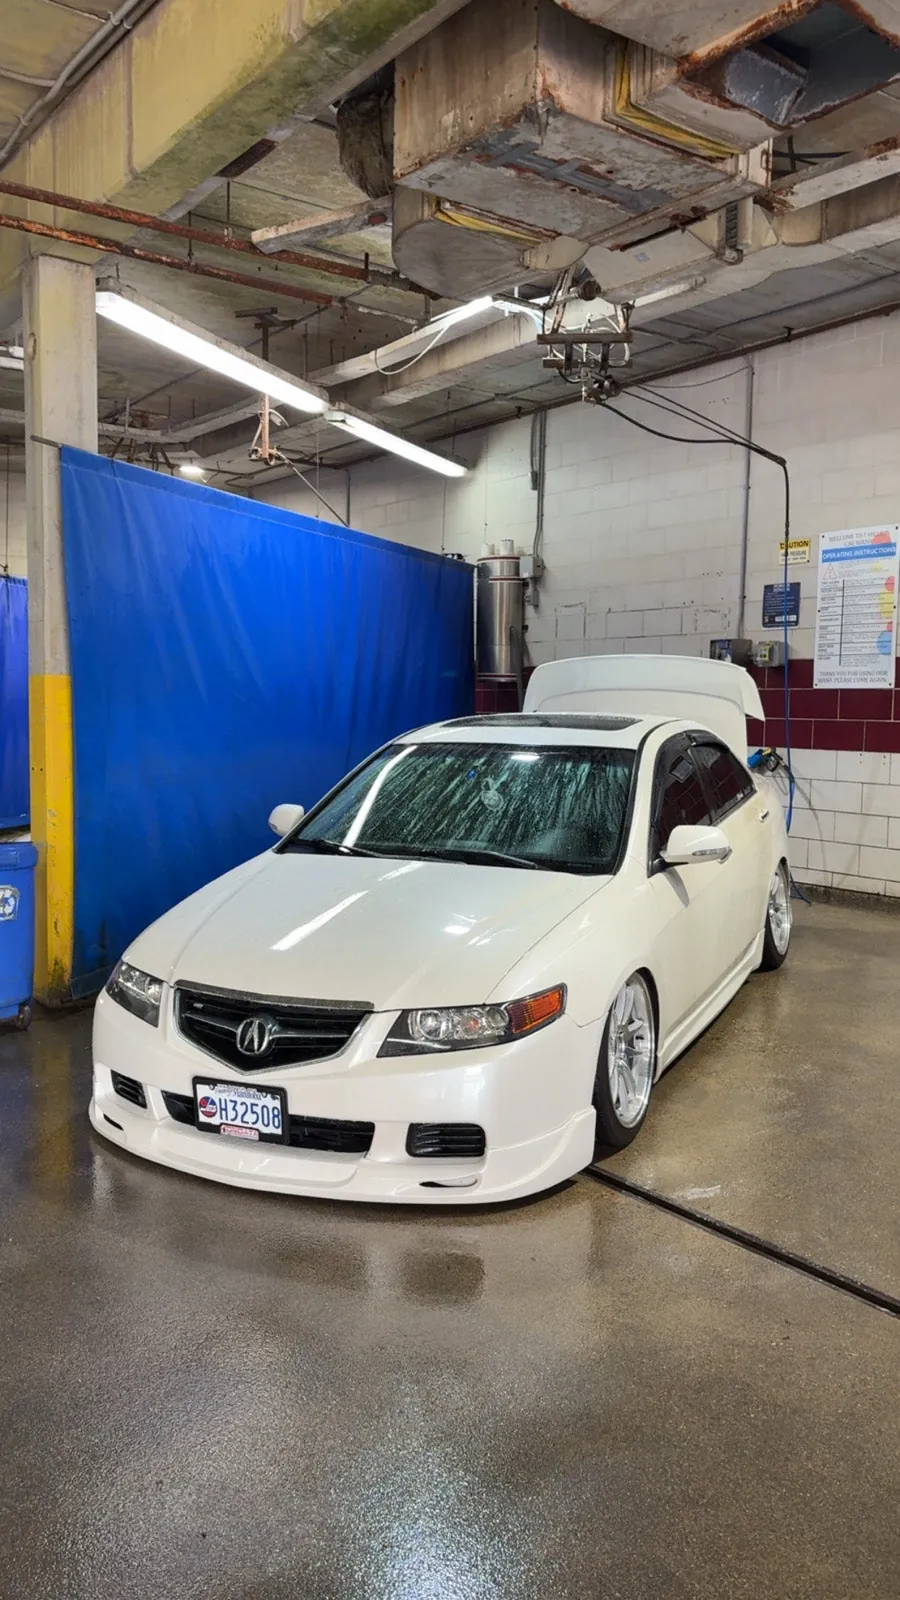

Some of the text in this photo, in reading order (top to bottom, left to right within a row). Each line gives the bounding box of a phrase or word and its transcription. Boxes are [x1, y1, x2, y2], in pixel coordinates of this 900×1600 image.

[780, 540, 809, 550] CUTION
[823, 546, 896, 560] OPERATING INSTRUCTIONS
[218, 1097, 280, 1130] H32508
